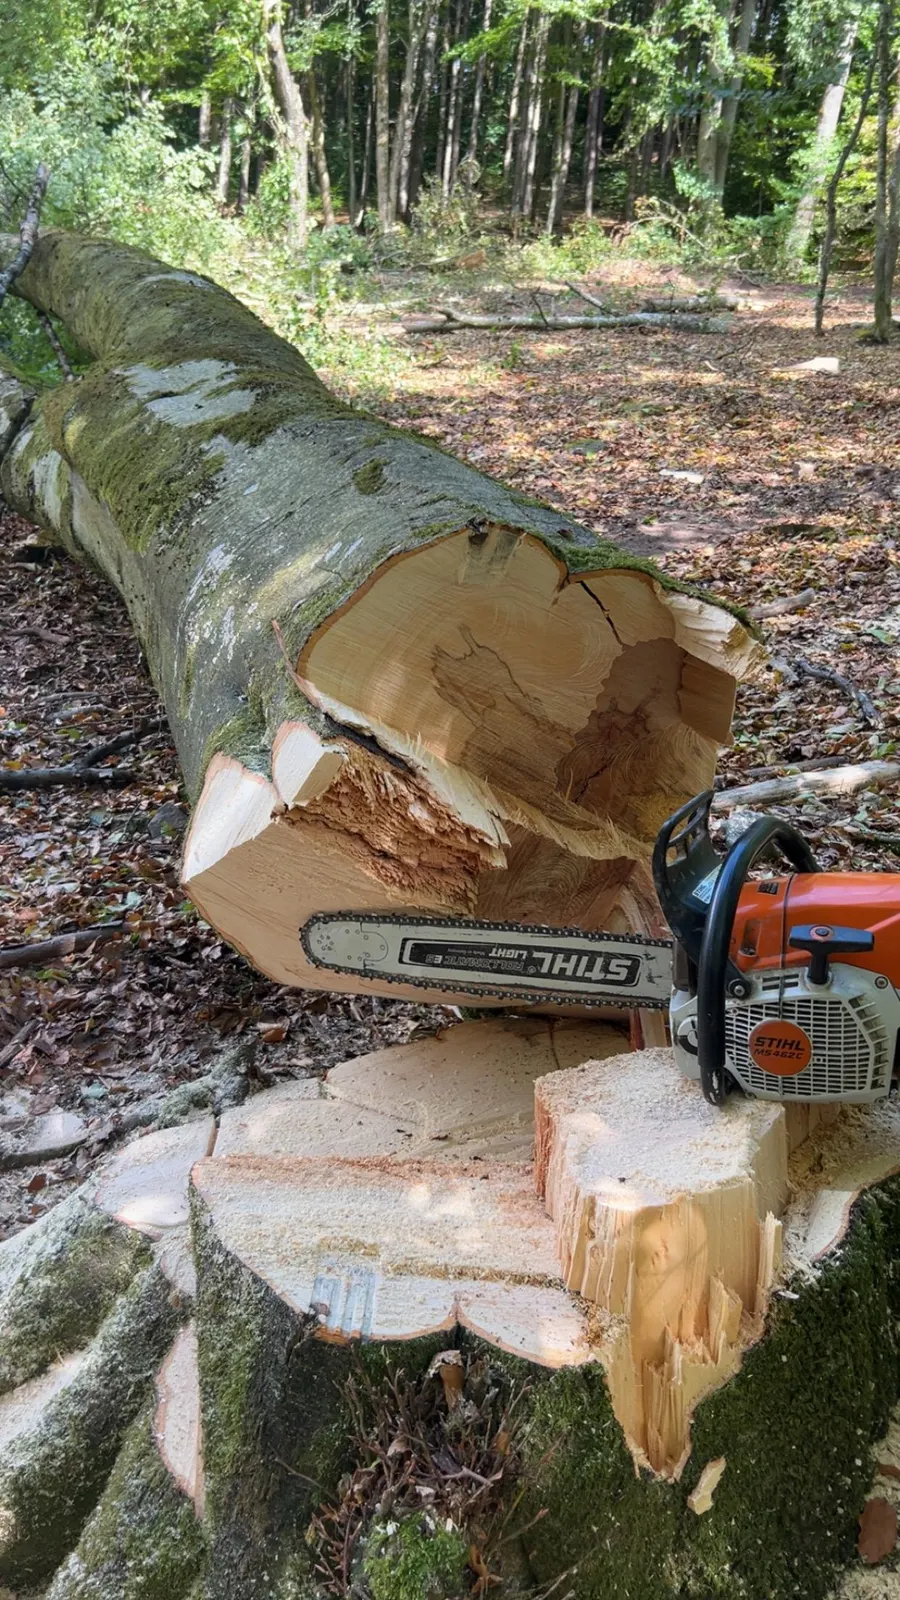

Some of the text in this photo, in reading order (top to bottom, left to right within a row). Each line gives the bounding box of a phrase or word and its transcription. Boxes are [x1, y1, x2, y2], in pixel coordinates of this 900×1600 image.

[489, 947, 528, 960] LIGHT
[444, 955, 524, 972] ROLLOMATIC
[532, 951, 632, 981] STIHL
[754, 1036, 805, 1052] STIHL
[754, 1048, 772, 1057] MS
